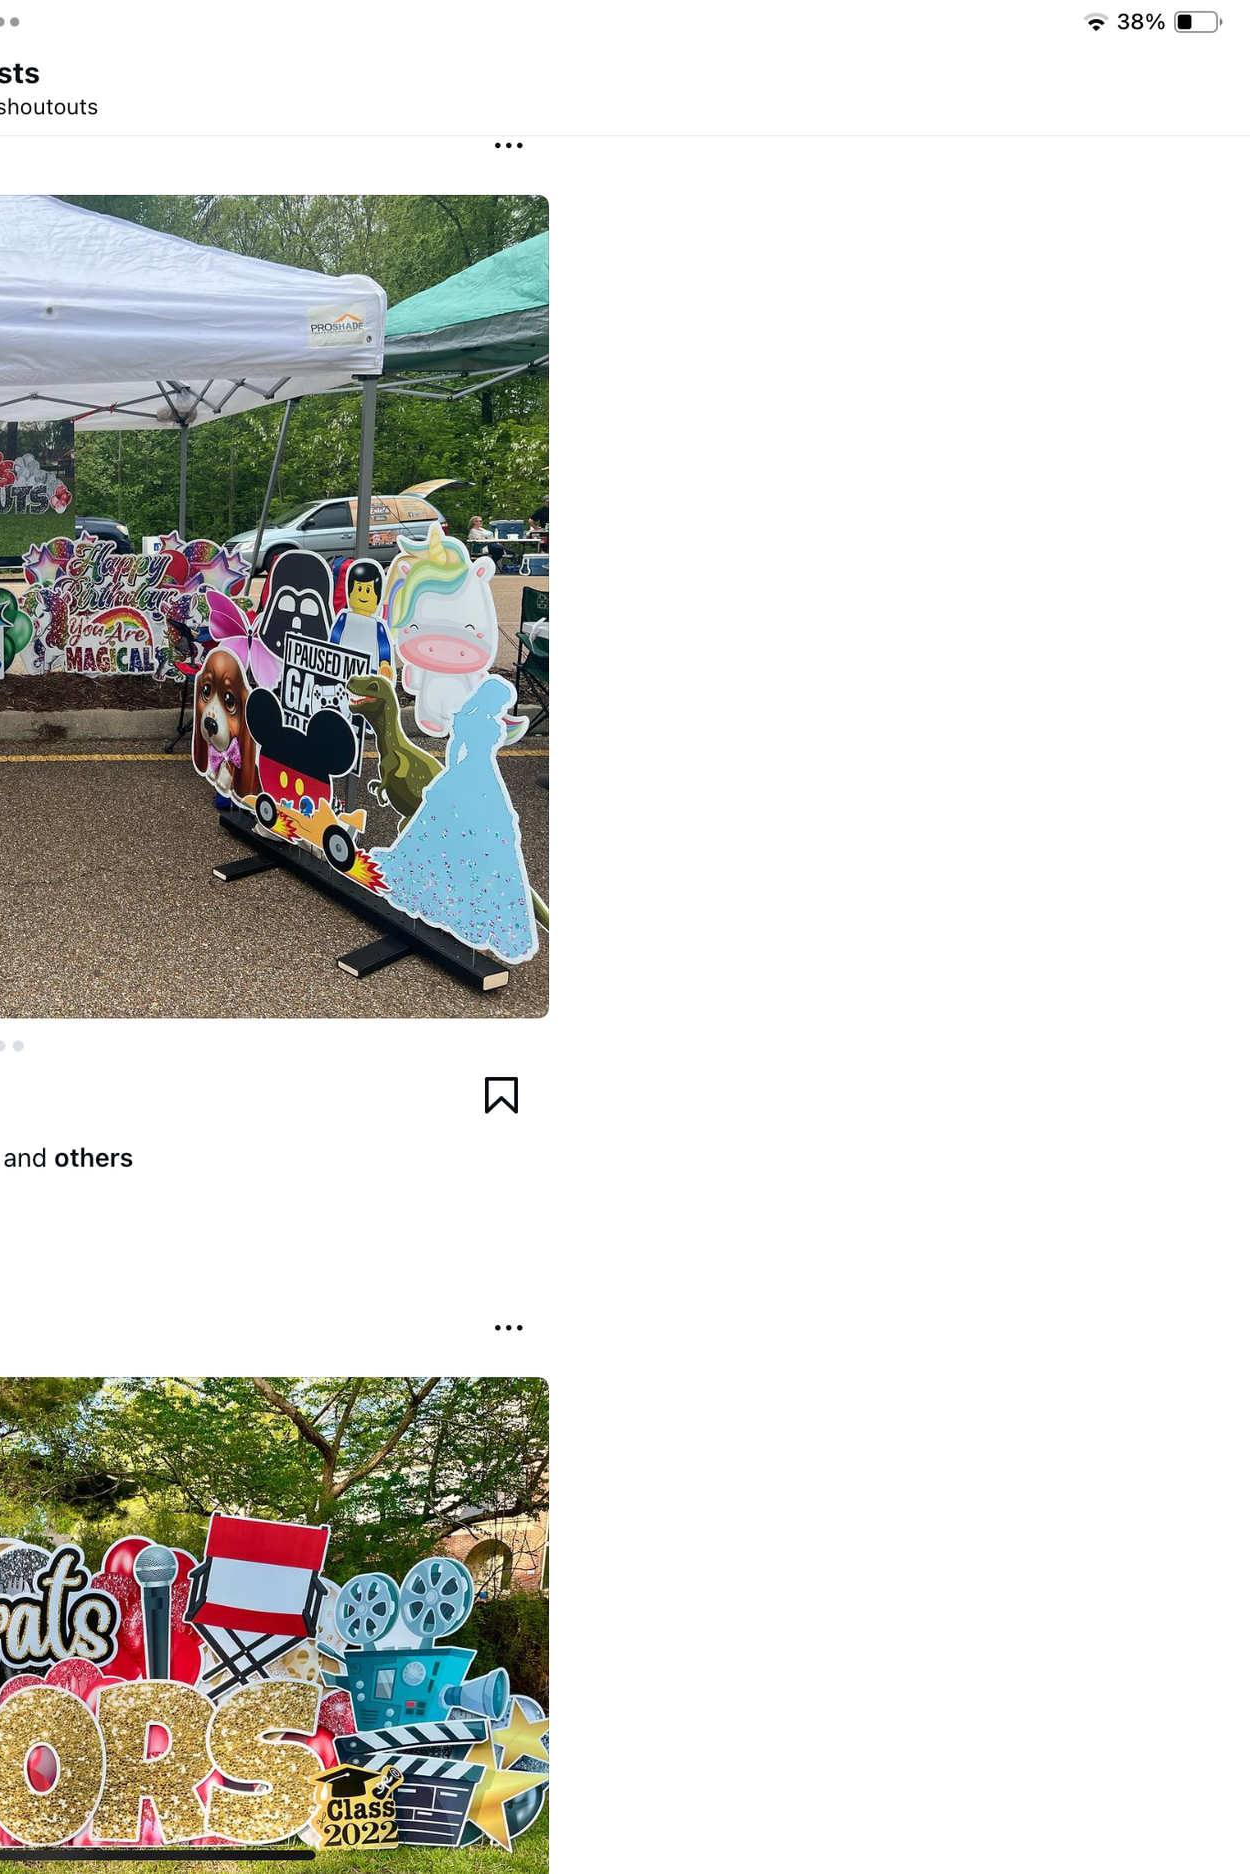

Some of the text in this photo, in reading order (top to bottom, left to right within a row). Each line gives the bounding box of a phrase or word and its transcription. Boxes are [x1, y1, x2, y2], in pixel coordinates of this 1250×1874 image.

[1117, 13, 1166, 31] 38%
[310, 322, 363, 333] PROSHADE
[68, 541, 171, 587] Happy
[69, 617, 146, 646] You Are
[288, 640, 292, 663] I
[294, 643, 341, 677] PAUSED
[3, 1146, 46, 1168] and
[54, 1146, 134, 1168] others
[316, 1812, 326, 1829] of
[327, 1799, 395, 1821] Class
[324, 1820, 398, 1847] 2022
